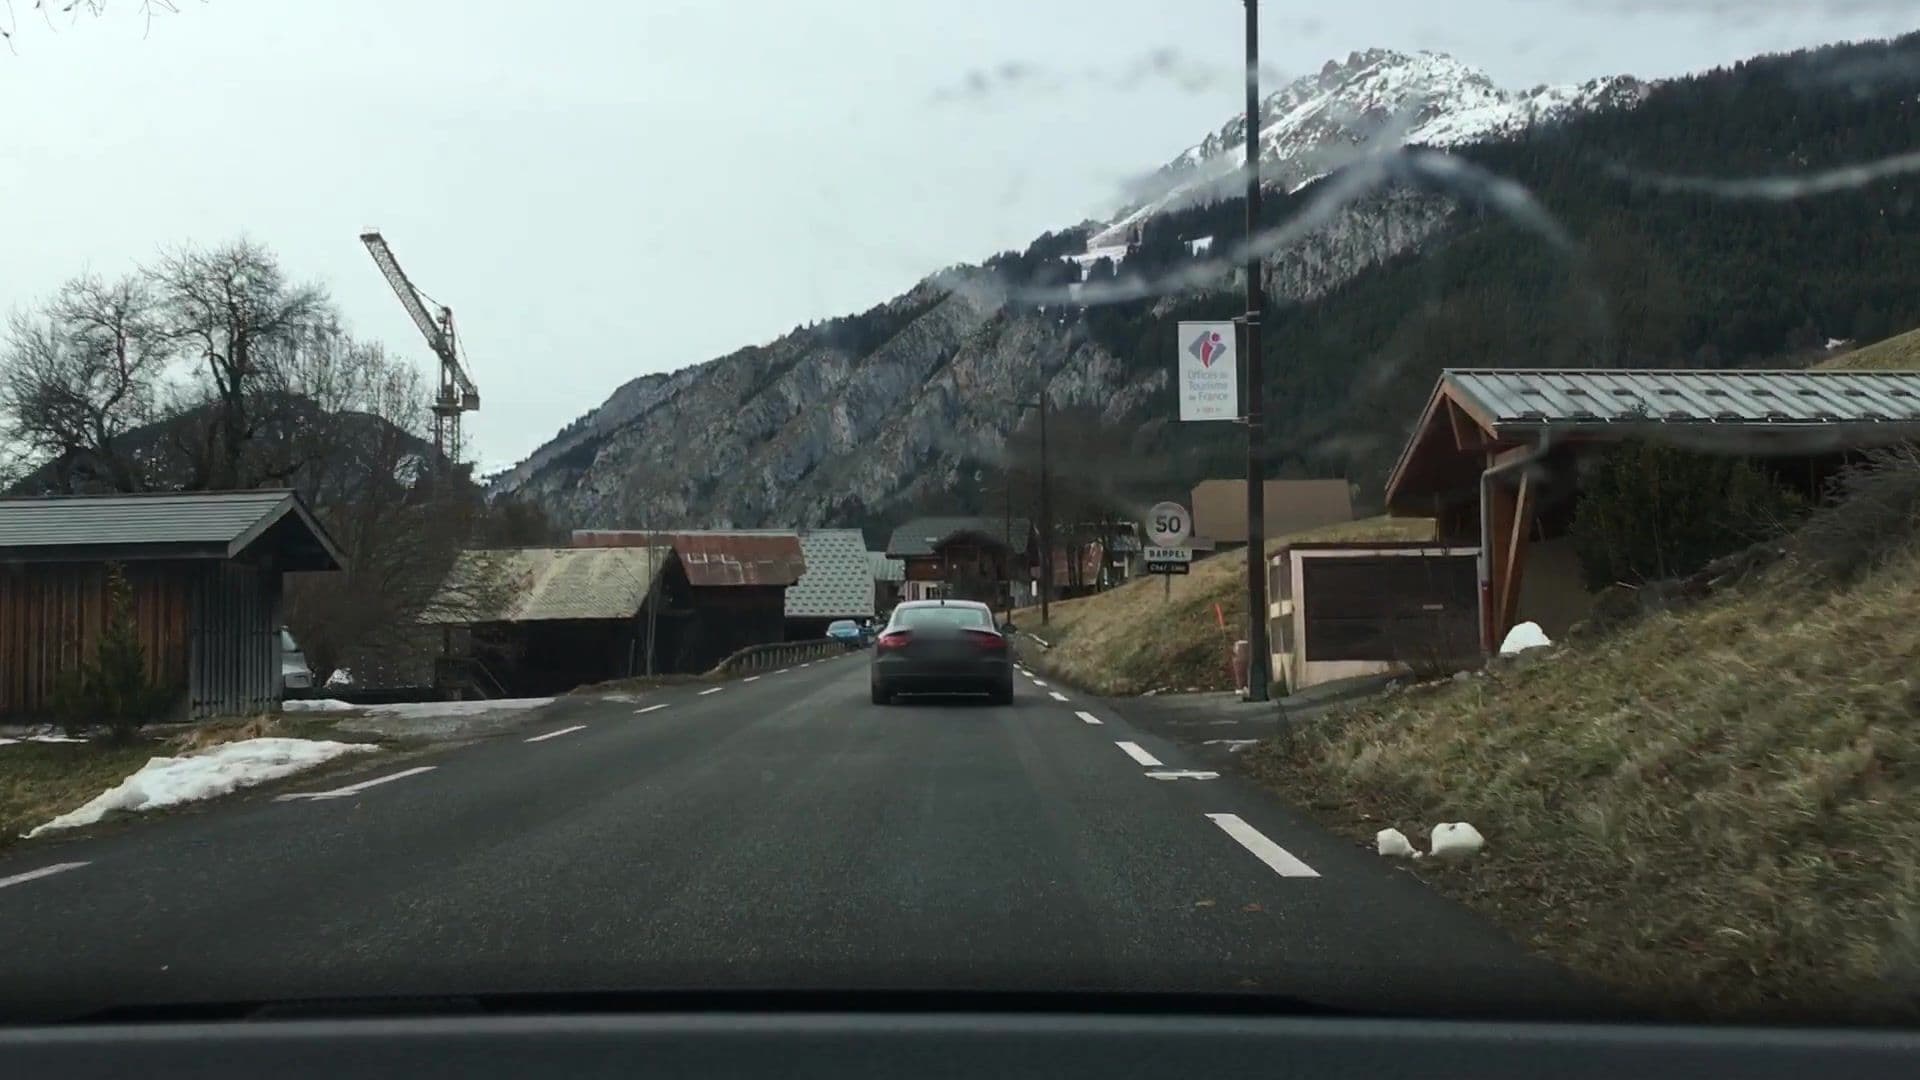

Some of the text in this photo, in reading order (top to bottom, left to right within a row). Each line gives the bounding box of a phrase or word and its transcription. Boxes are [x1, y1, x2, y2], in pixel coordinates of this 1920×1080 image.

[1188, 381, 1228, 391] Tourisme
[1198, 391, 1229, 401] France
[1156, 515, 1181, 533] 50
